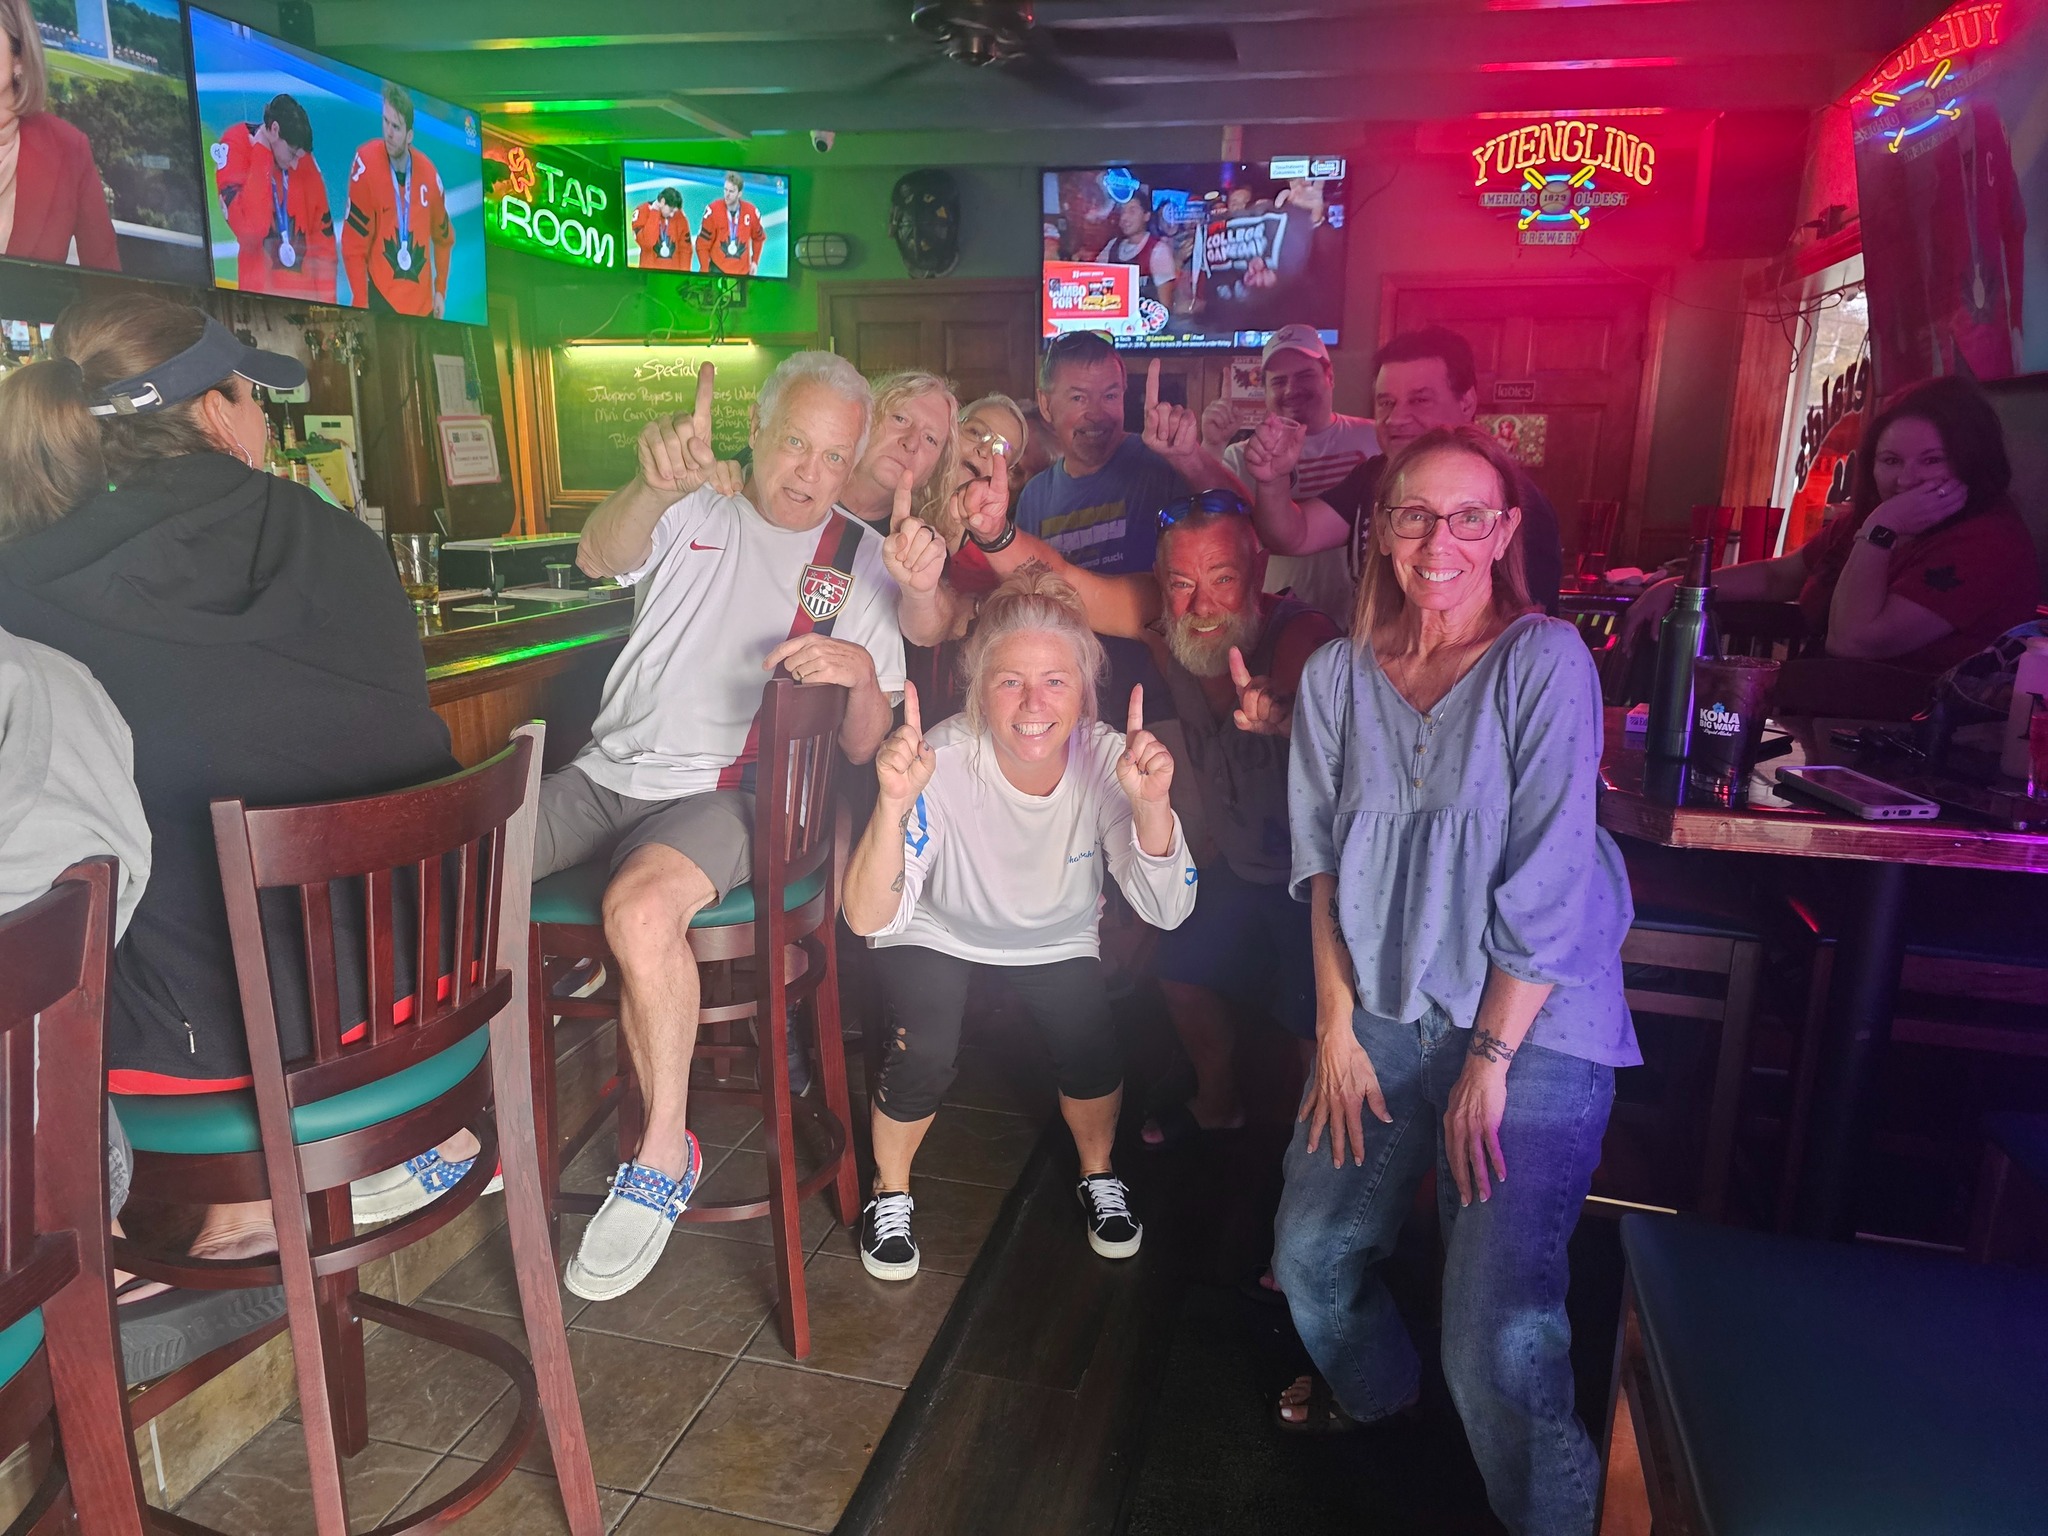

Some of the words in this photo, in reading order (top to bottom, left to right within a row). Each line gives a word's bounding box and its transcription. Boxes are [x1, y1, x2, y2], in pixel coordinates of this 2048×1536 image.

[1472, 120, 1655, 186] YUENGLING
[536, 161, 607, 217] TAP
[1574, 192, 1629, 206] OLDEST
[501, 194, 614, 268] ROOM
[1519, 230, 1582, 244] BREWERY
[639, 357, 699, 381] Special
[1700, 708, 1739, 725] KONA
[1700, 720, 1712, 728] BIG
[1713, 722, 1740, 732] WAVE
